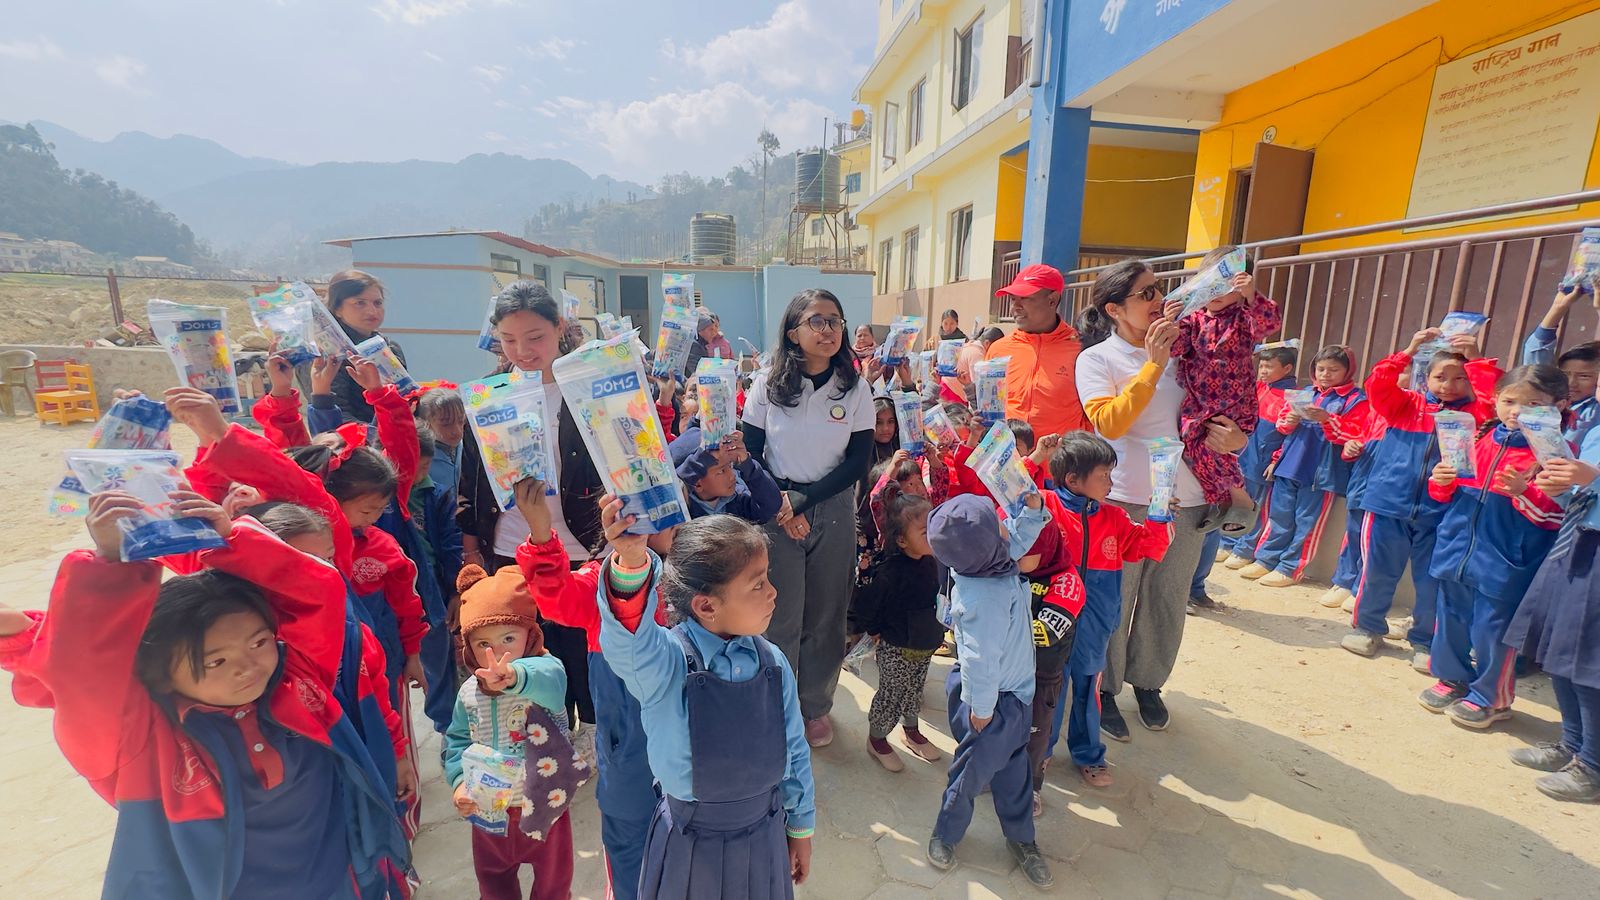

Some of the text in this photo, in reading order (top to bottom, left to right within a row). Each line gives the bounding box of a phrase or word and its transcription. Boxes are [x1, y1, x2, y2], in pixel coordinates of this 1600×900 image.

[1472, 33, 1561, 74] राष्ट्रिय गान
[183, 321, 221, 331] DOMS
[594, 375, 635, 396] DOMS
[478, 408, 515, 424] DOMS
